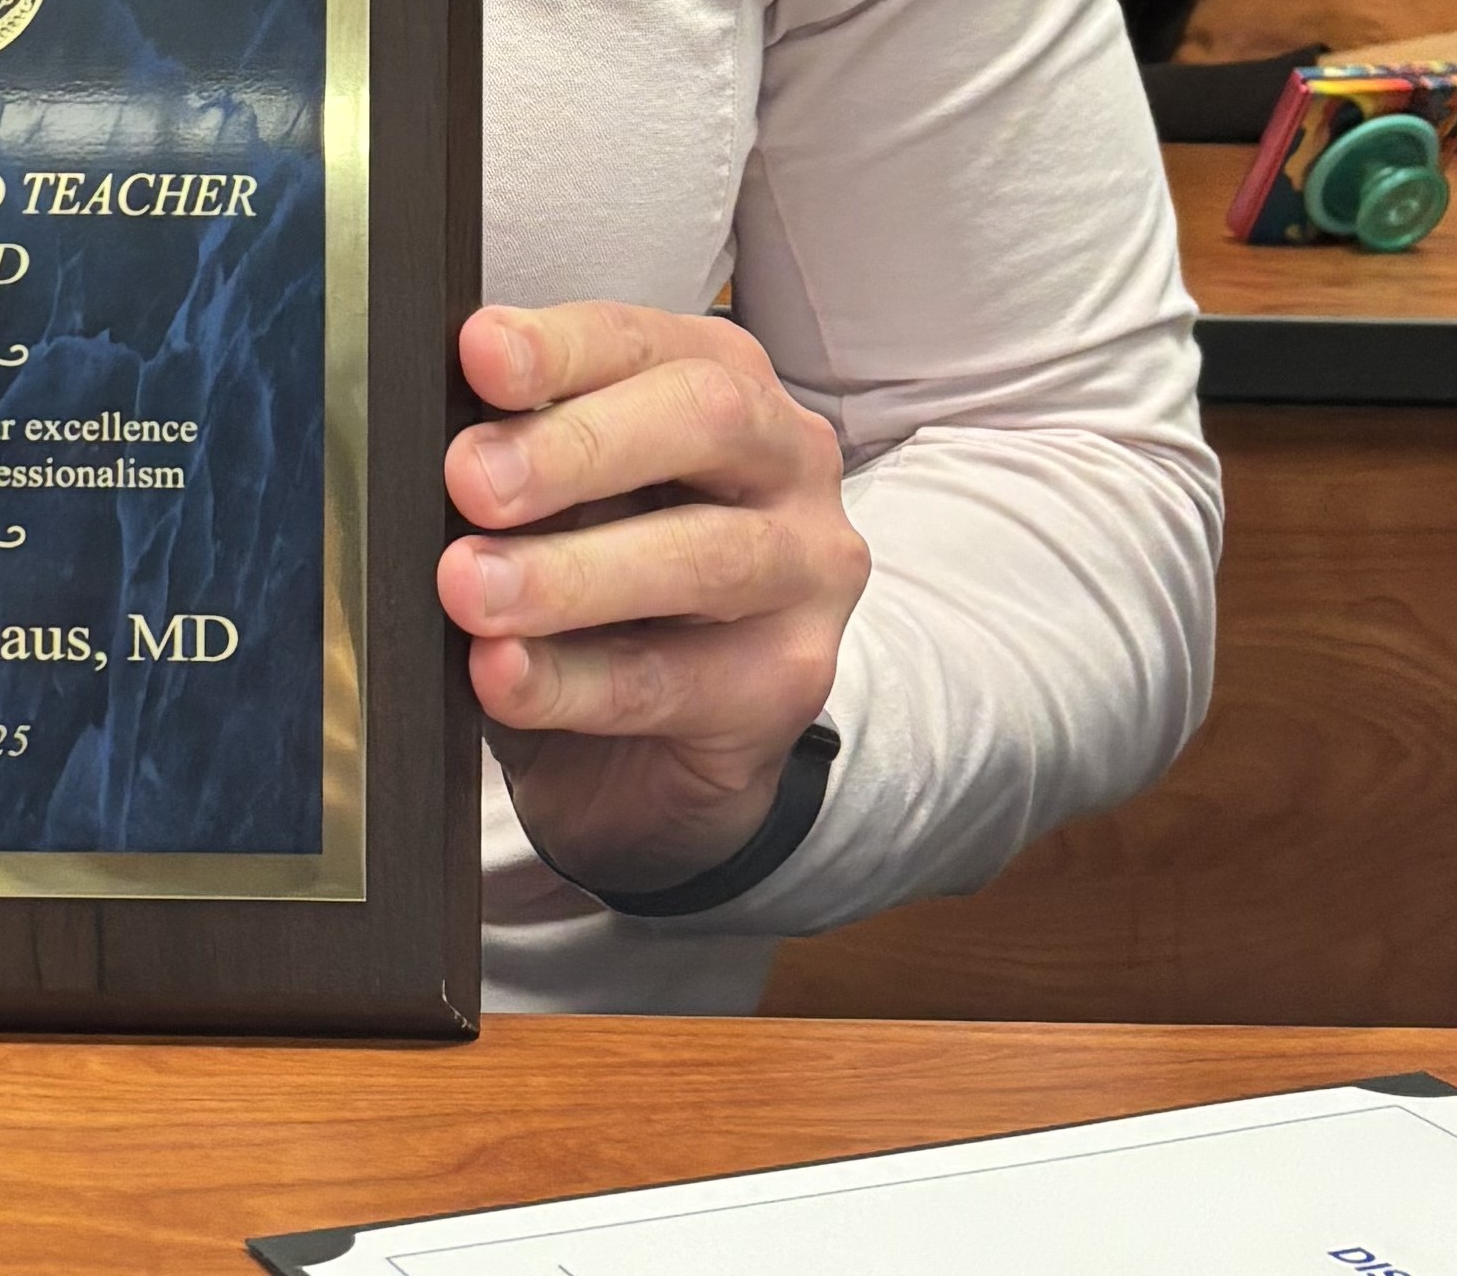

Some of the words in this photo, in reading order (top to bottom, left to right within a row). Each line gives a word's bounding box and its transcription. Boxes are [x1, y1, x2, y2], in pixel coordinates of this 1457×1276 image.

[21, 171, 259, 218] TEACHER
[23, 410, 199, 444] excellence
[126, 613, 240, 663] MD
